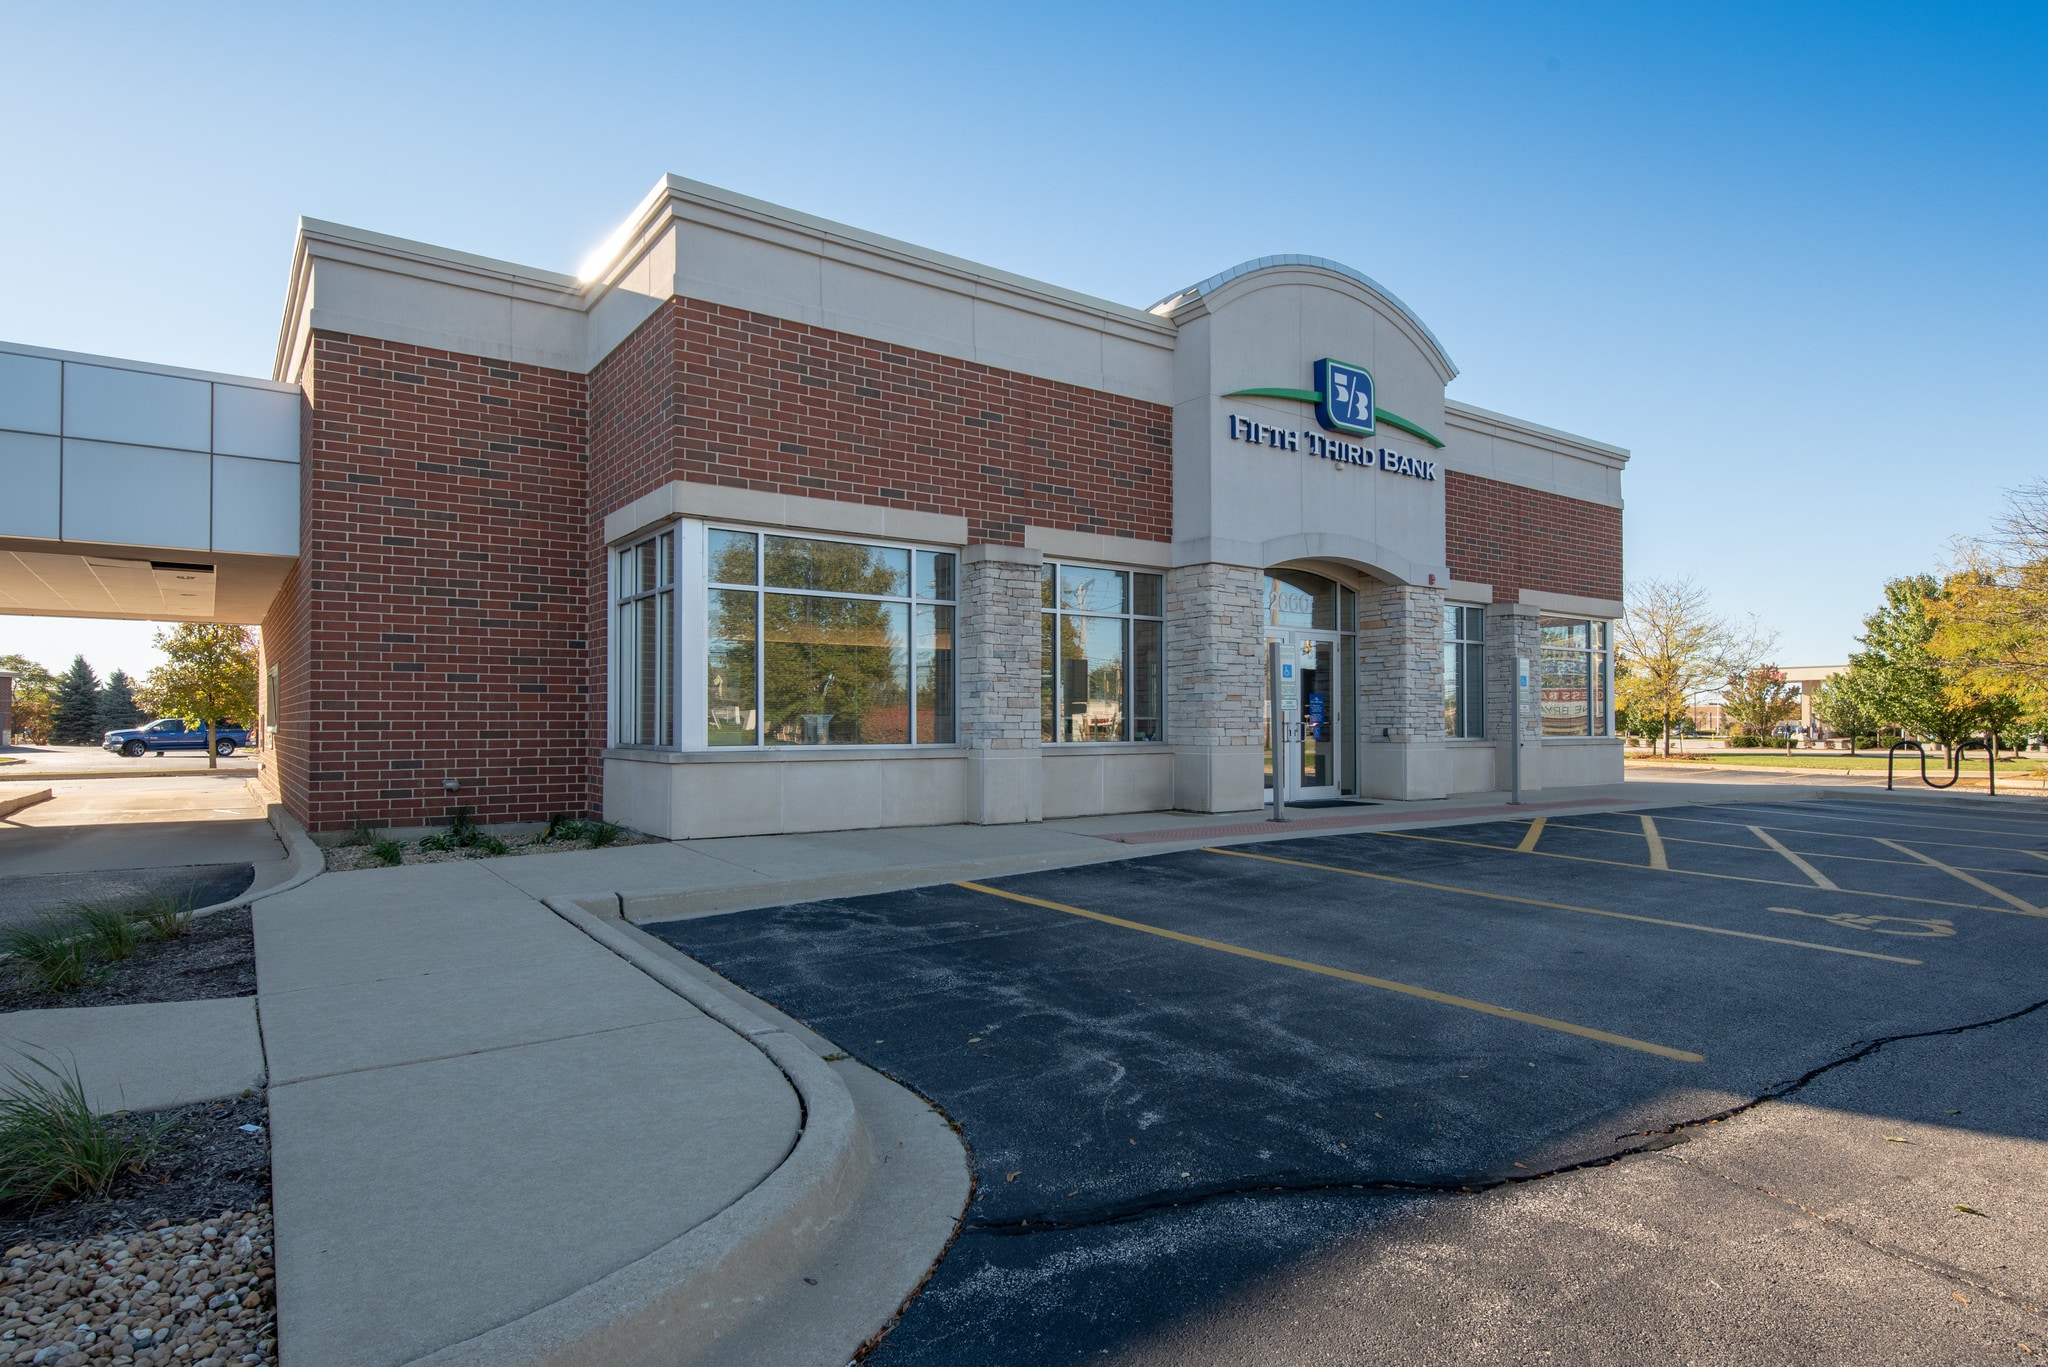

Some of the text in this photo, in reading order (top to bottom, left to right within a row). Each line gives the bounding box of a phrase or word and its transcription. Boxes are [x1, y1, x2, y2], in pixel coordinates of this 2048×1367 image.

[1229, 414, 1438, 481] FIFTH THIRD BANK
[1269, 591, 1309, 613] 2660
